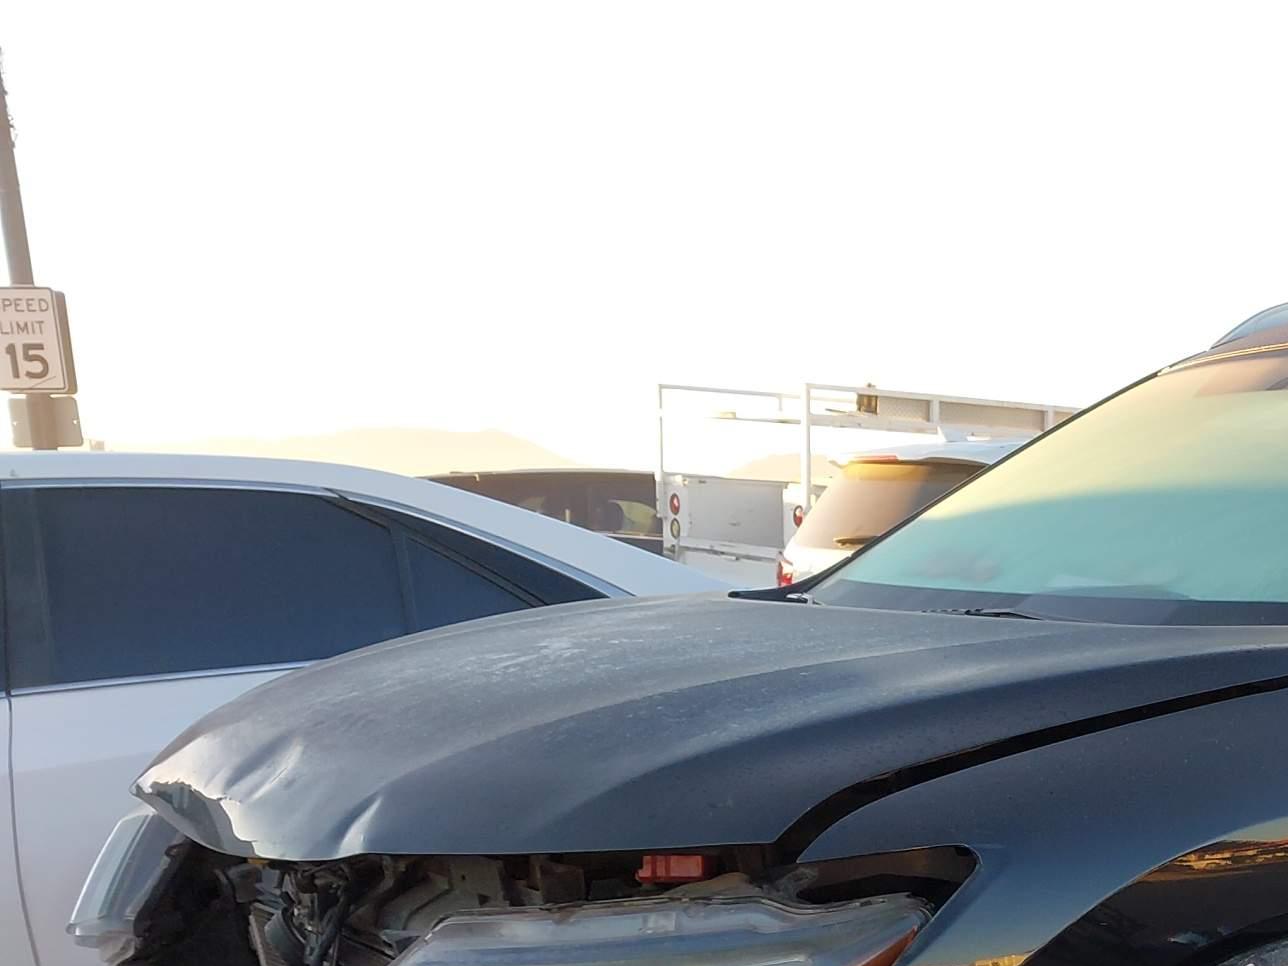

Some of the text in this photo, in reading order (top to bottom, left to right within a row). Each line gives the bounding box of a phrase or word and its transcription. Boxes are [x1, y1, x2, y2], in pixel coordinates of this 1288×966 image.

[0, 298, 49, 312] PEED
[0, 320, 44, 335] LIMIT
[5, 343, 49, 379] 15
